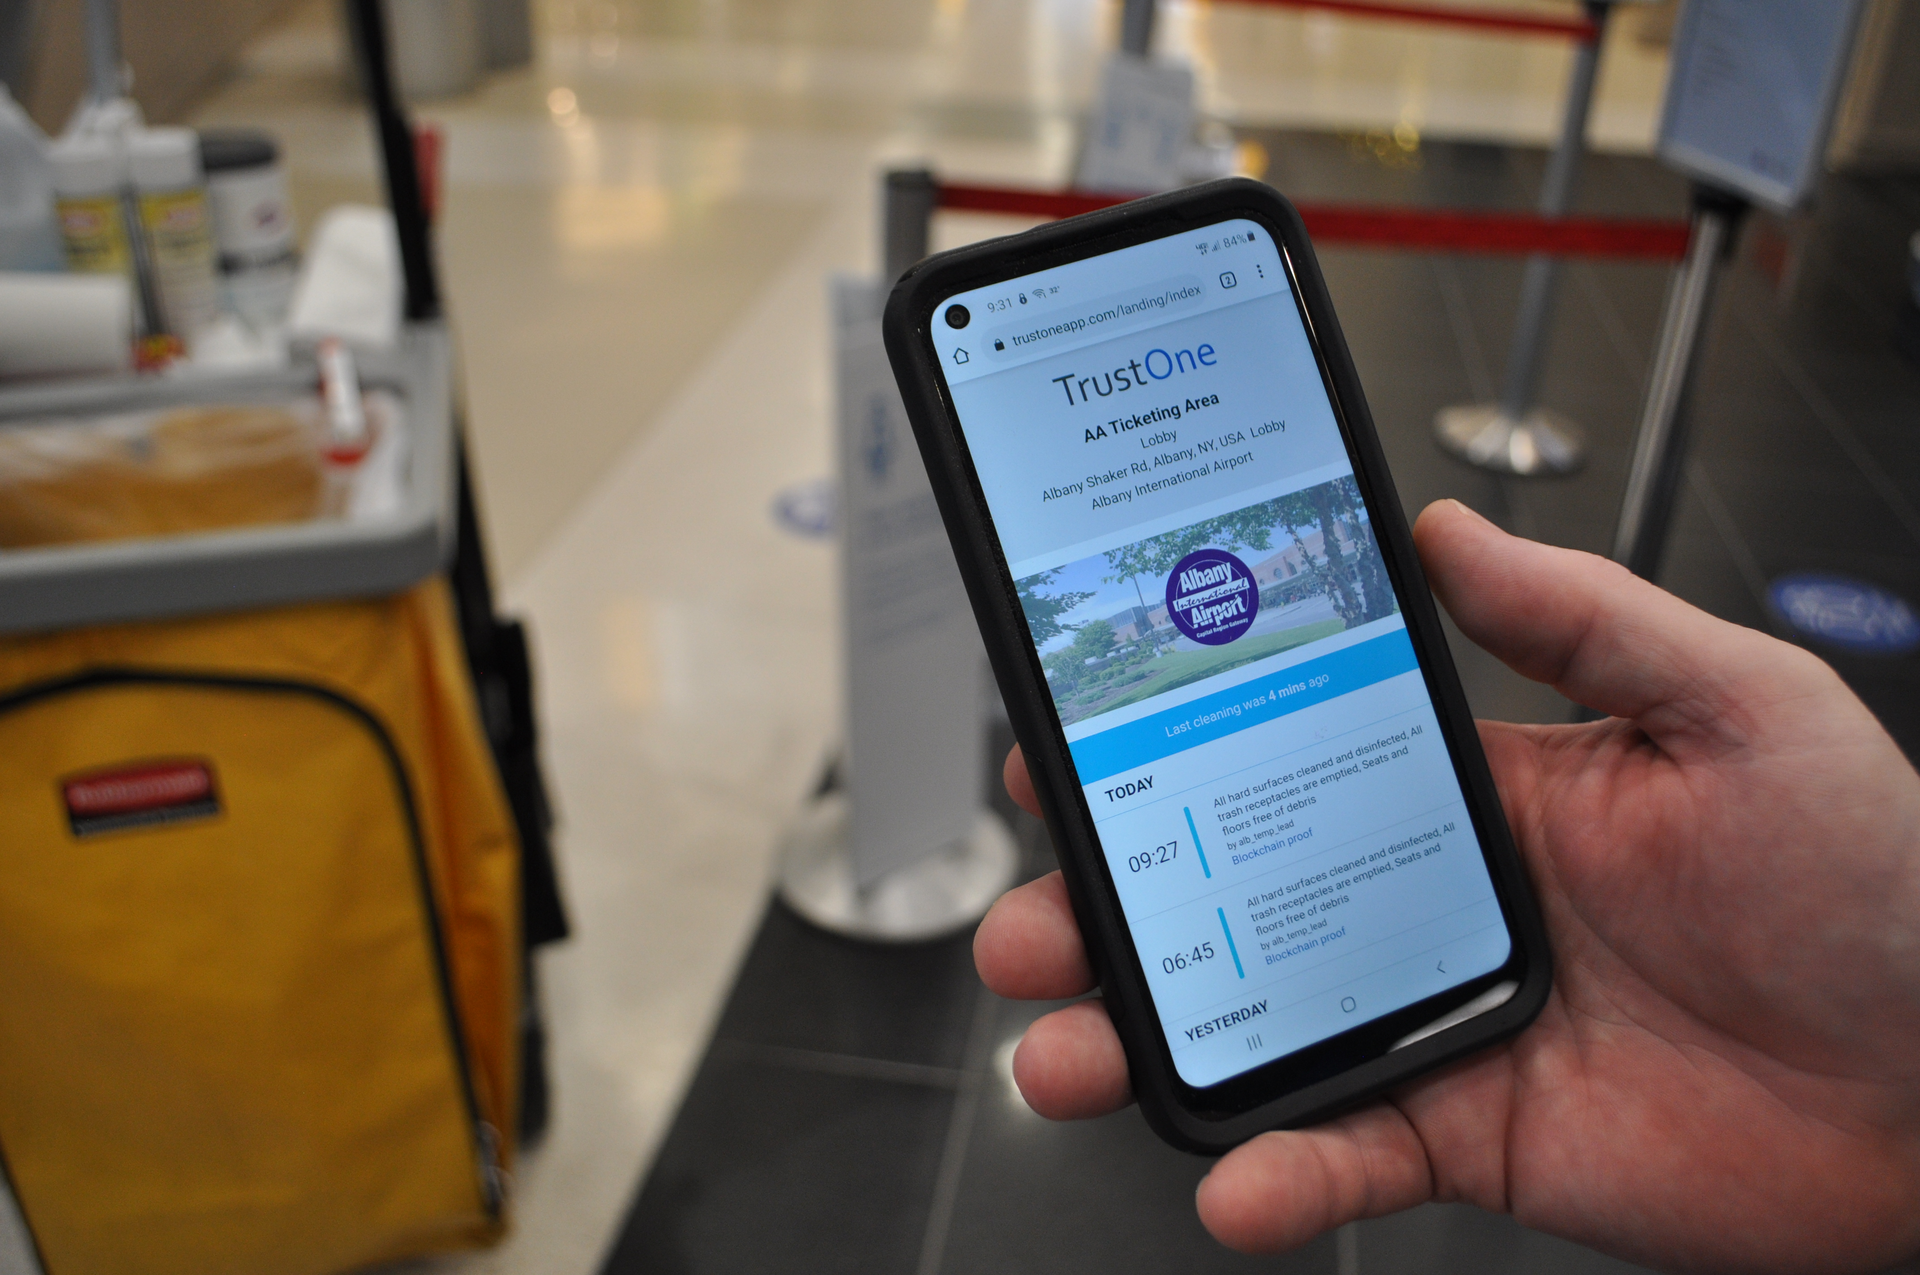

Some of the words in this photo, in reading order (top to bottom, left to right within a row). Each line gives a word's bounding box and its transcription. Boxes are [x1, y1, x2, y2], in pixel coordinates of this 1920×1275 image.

[1225, 276, 1232, 285] 2
[987, 298, 1012, 313] 9:31
[1012, 285, 1202, 346] trustoneapp.com/landing/index
[1052, 343, 1218, 406] TrustOne
[1084, 425, 1108, 443] AA
[1108, 404, 1182, 436] Ticketing
[1185, 393, 1220, 413] Area
[1140, 430, 1178, 449] Lobby
[1042, 481, 1083, 502] Albany
[1086, 468, 1129, 488] Shaker
[1132, 455, 1151, 473] Rd,
[1154, 447, 1197, 469] Albany,
[1198, 439, 1218, 454] NY,
[1219, 431, 1246, 447] USA
[1250, 418, 1286, 438] Lobby
[1092, 489, 1132, 510] Albany
[1135, 464, 1211, 496] International
[1214, 451, 1254, 475] Airport
[1176, 578, 1247, 610] International
[1180, 562, 1232, 593] Albany
[1191, 594, 1246, 628] Airport
[1165, 720, 1191, 737] Last
[1193, 703, 1241, 728] cleaning
[1243, 694, 1266, 710] was
[1268, 690, 1277, 701] 4
[1278, 682, 1306, 698] mins
[1308, 673, 1330, 689] ago
[1214, 796, 1226, 808] All
[1227, 786, 1251, 803] hard
[1253, 773, 1294, 795] surfaces
[1296, 758, 1334, 778] cleaned
[1336, 750, 1354, 764] and
[1356, 731, 1410, 758] disinfected,
[1411, 725, 1423, 737] All
[1218, 806, 1243, 822] trash
[1244, 784, 1301, 814] receptacles
[1303, 778, 1319, 791] are
[1320, 764, 1361, 788] emptied,
[1362, 753, 1389, 771] Seats
[1391, 746, 1409, 759] and
[1104, 775, 1154, 803] TODAY
[1222, 818, 1251, 835] floors
[1253, 810, 1273, 826] free
[1274, 806, 1285, 818] of
[1287, 794, 1317, 813] debris
[1128, 841, 1179, 874] 09:27
[1227, 841, 1237, 851] by
[1232, 838, 1286, 865] Blockchain
[1287, 827, 1313, 847] proof
[1247, 896, 1259, 909] All
[1260, 887, 1284, 903] hard
[1286, 871, 1328, 896] surfaces
[1329, 856, 1367, 878] cleaned
[1369, 849, 1386, 862] and
[1388, 829, 1442, 856] disinfected,
[1443, 822, 1455, 834] All
[1251, 905, 1277, 922] trash
[1278, 884, 1335, 914] receptacles
[1336, 877, 1351, 891] are
[1353, 863, 1394, 887] emptied,
[1394, 852, 1422, 870] Seats
[1423, 844, 1441, 858] and
[1256, 918, 1285, 936] floors
[1286, 911, 1306, 925] free
[1307, 905, 1318, 918] of
[1319, 894, 1350, 913] debris
[1162, 942, 1215, 975] 06:45
[1260, 940, 1270, 951] by
[1265, 937, 1319, 965] Blockchain
[1320, 927, 1347, 947] proof
[1185, 1000, 1269, 1042] YESTERDAY
